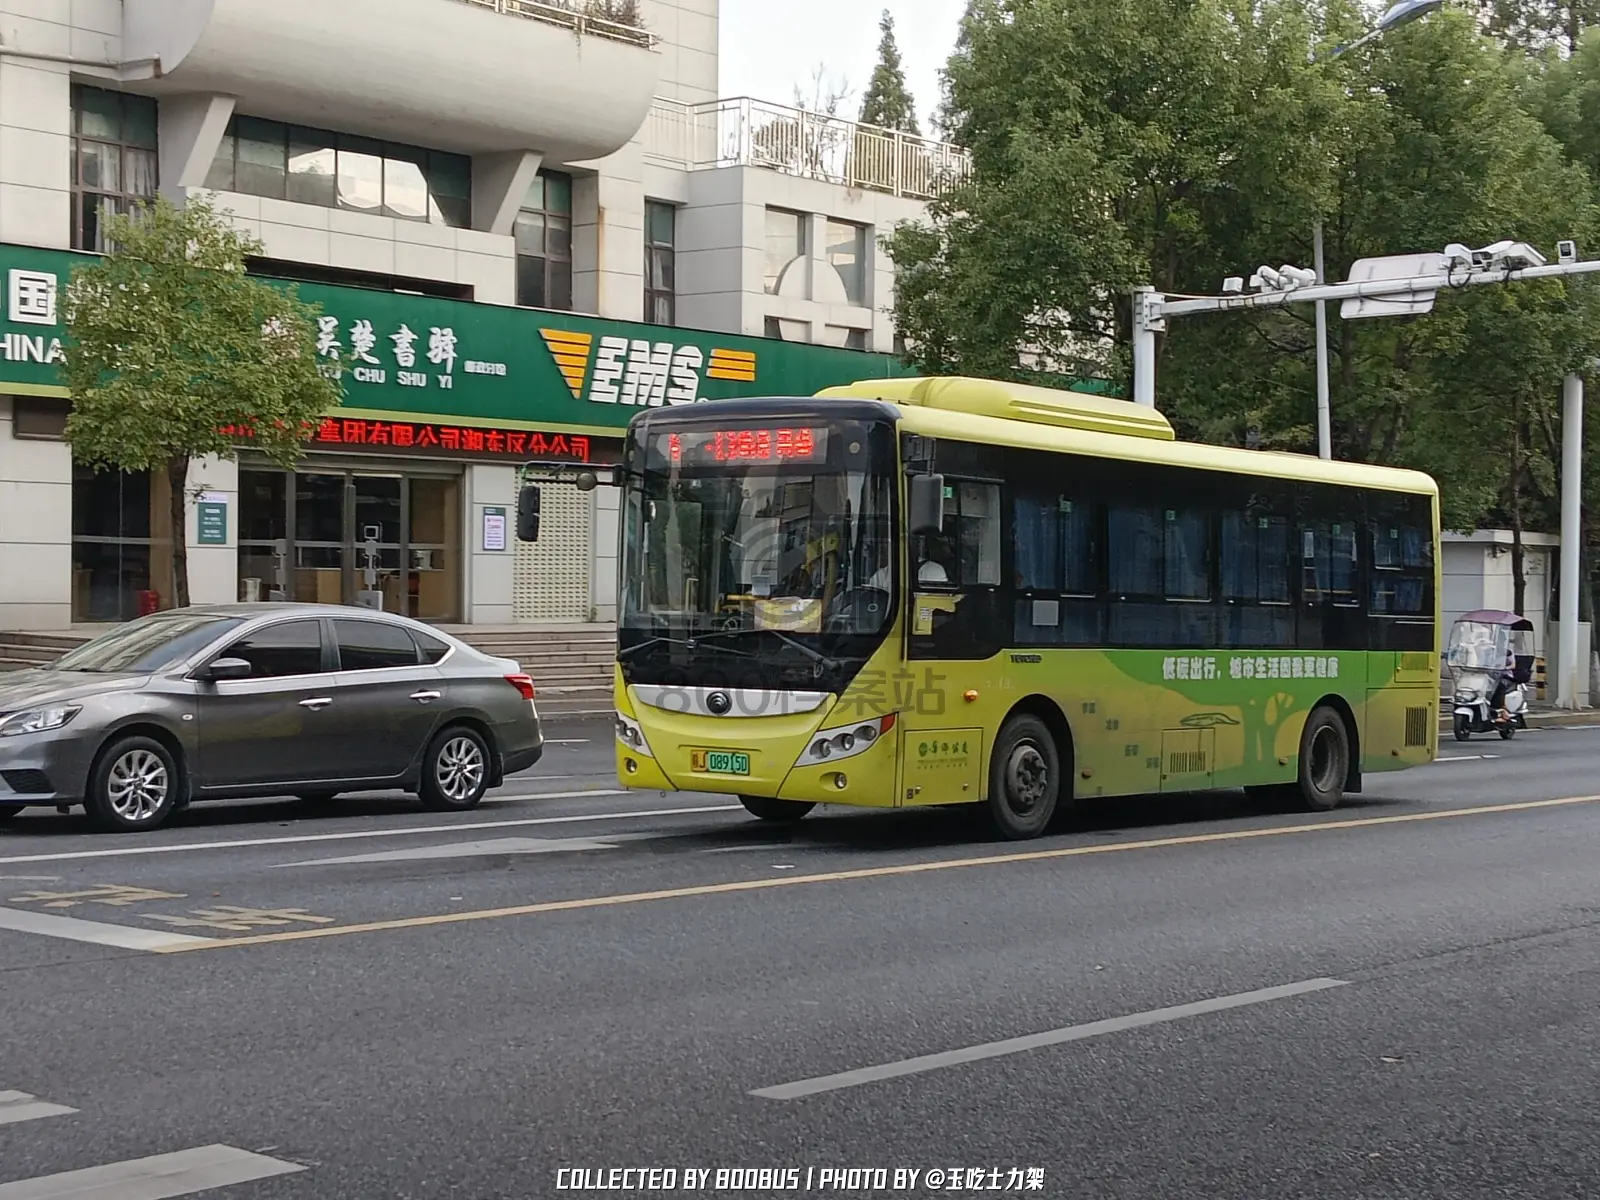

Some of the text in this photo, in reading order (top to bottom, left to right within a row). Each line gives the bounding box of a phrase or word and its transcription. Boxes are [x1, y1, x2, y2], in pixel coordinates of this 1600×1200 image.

[353, 367, 387, 384] CHU
[396, 370, 428, 388] SHU
[437, 374, 454, 389] YI
[588, 335, 704, 408] EMS
